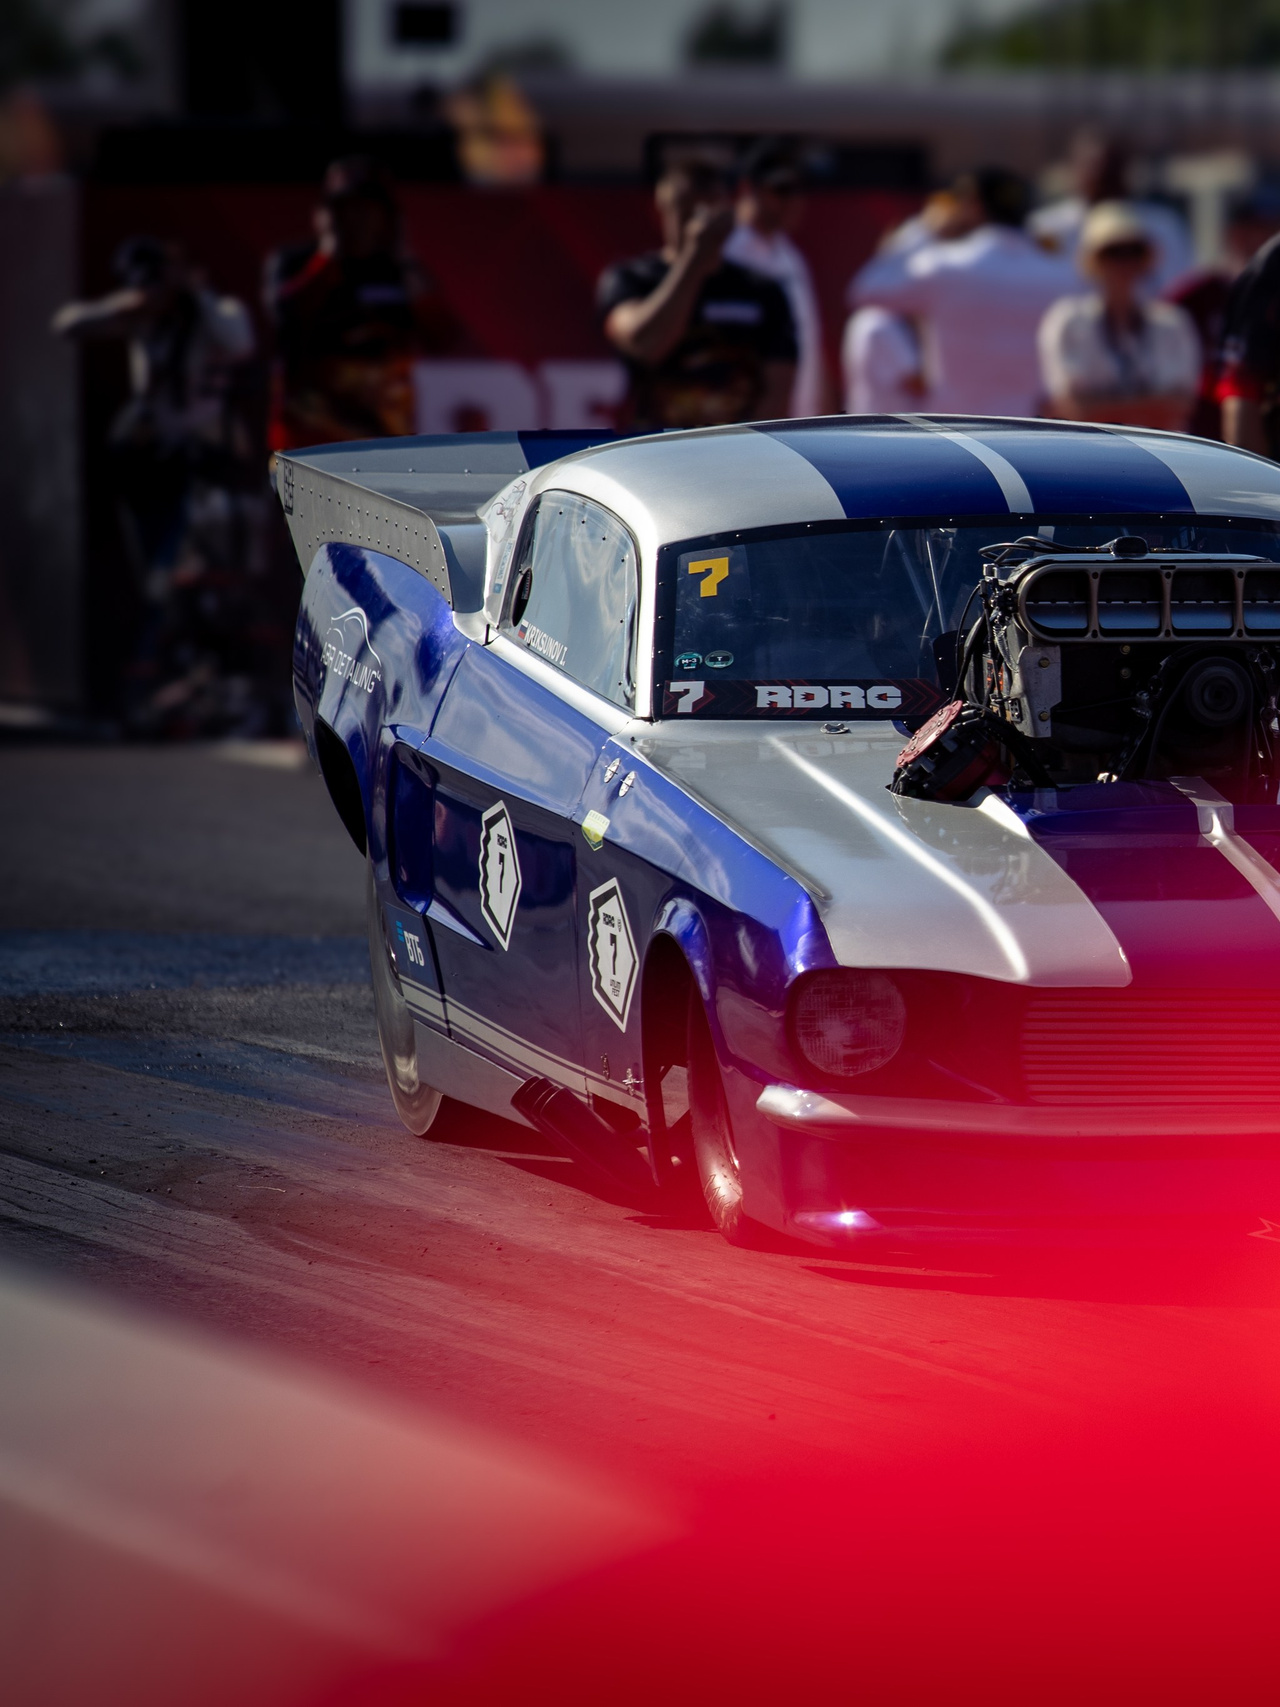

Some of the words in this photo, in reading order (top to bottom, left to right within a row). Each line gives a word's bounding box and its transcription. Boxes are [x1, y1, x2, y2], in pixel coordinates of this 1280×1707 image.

[688, 556, 729, 598] 7
[333, 651, 377, 693] DETAILING
[669, 681, 705, 713] 7
[754, 685, 902, 709] RDRC
[499, 852, 505, 893] 7
[403, 930, 424, 966] ВТБ
[610, 933, 617, 975] 7
